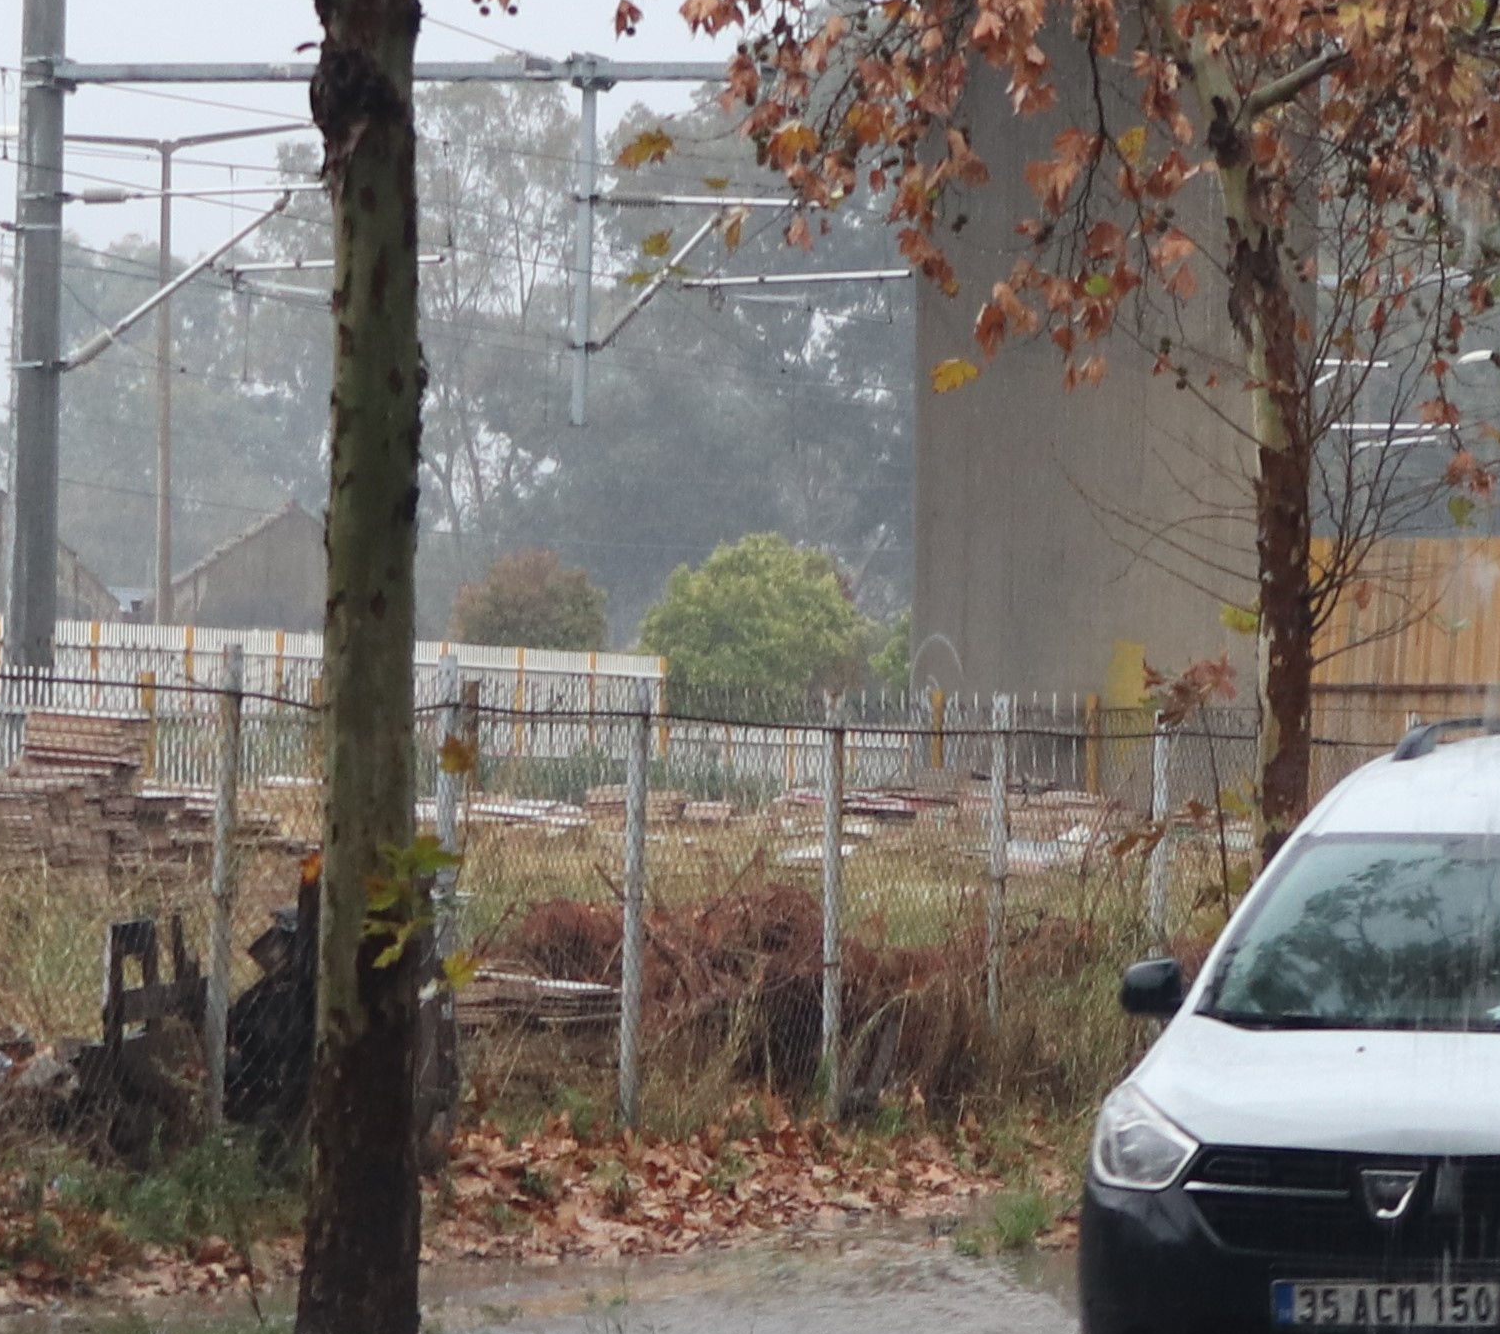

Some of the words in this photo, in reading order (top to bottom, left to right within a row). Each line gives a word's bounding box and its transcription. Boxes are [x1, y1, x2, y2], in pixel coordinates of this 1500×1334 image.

[1299, 1287, 1340, 1322] 35
[1353, 1288, 1417, 1323] ACM
[1431, 1287, 1492, 1322] 150
